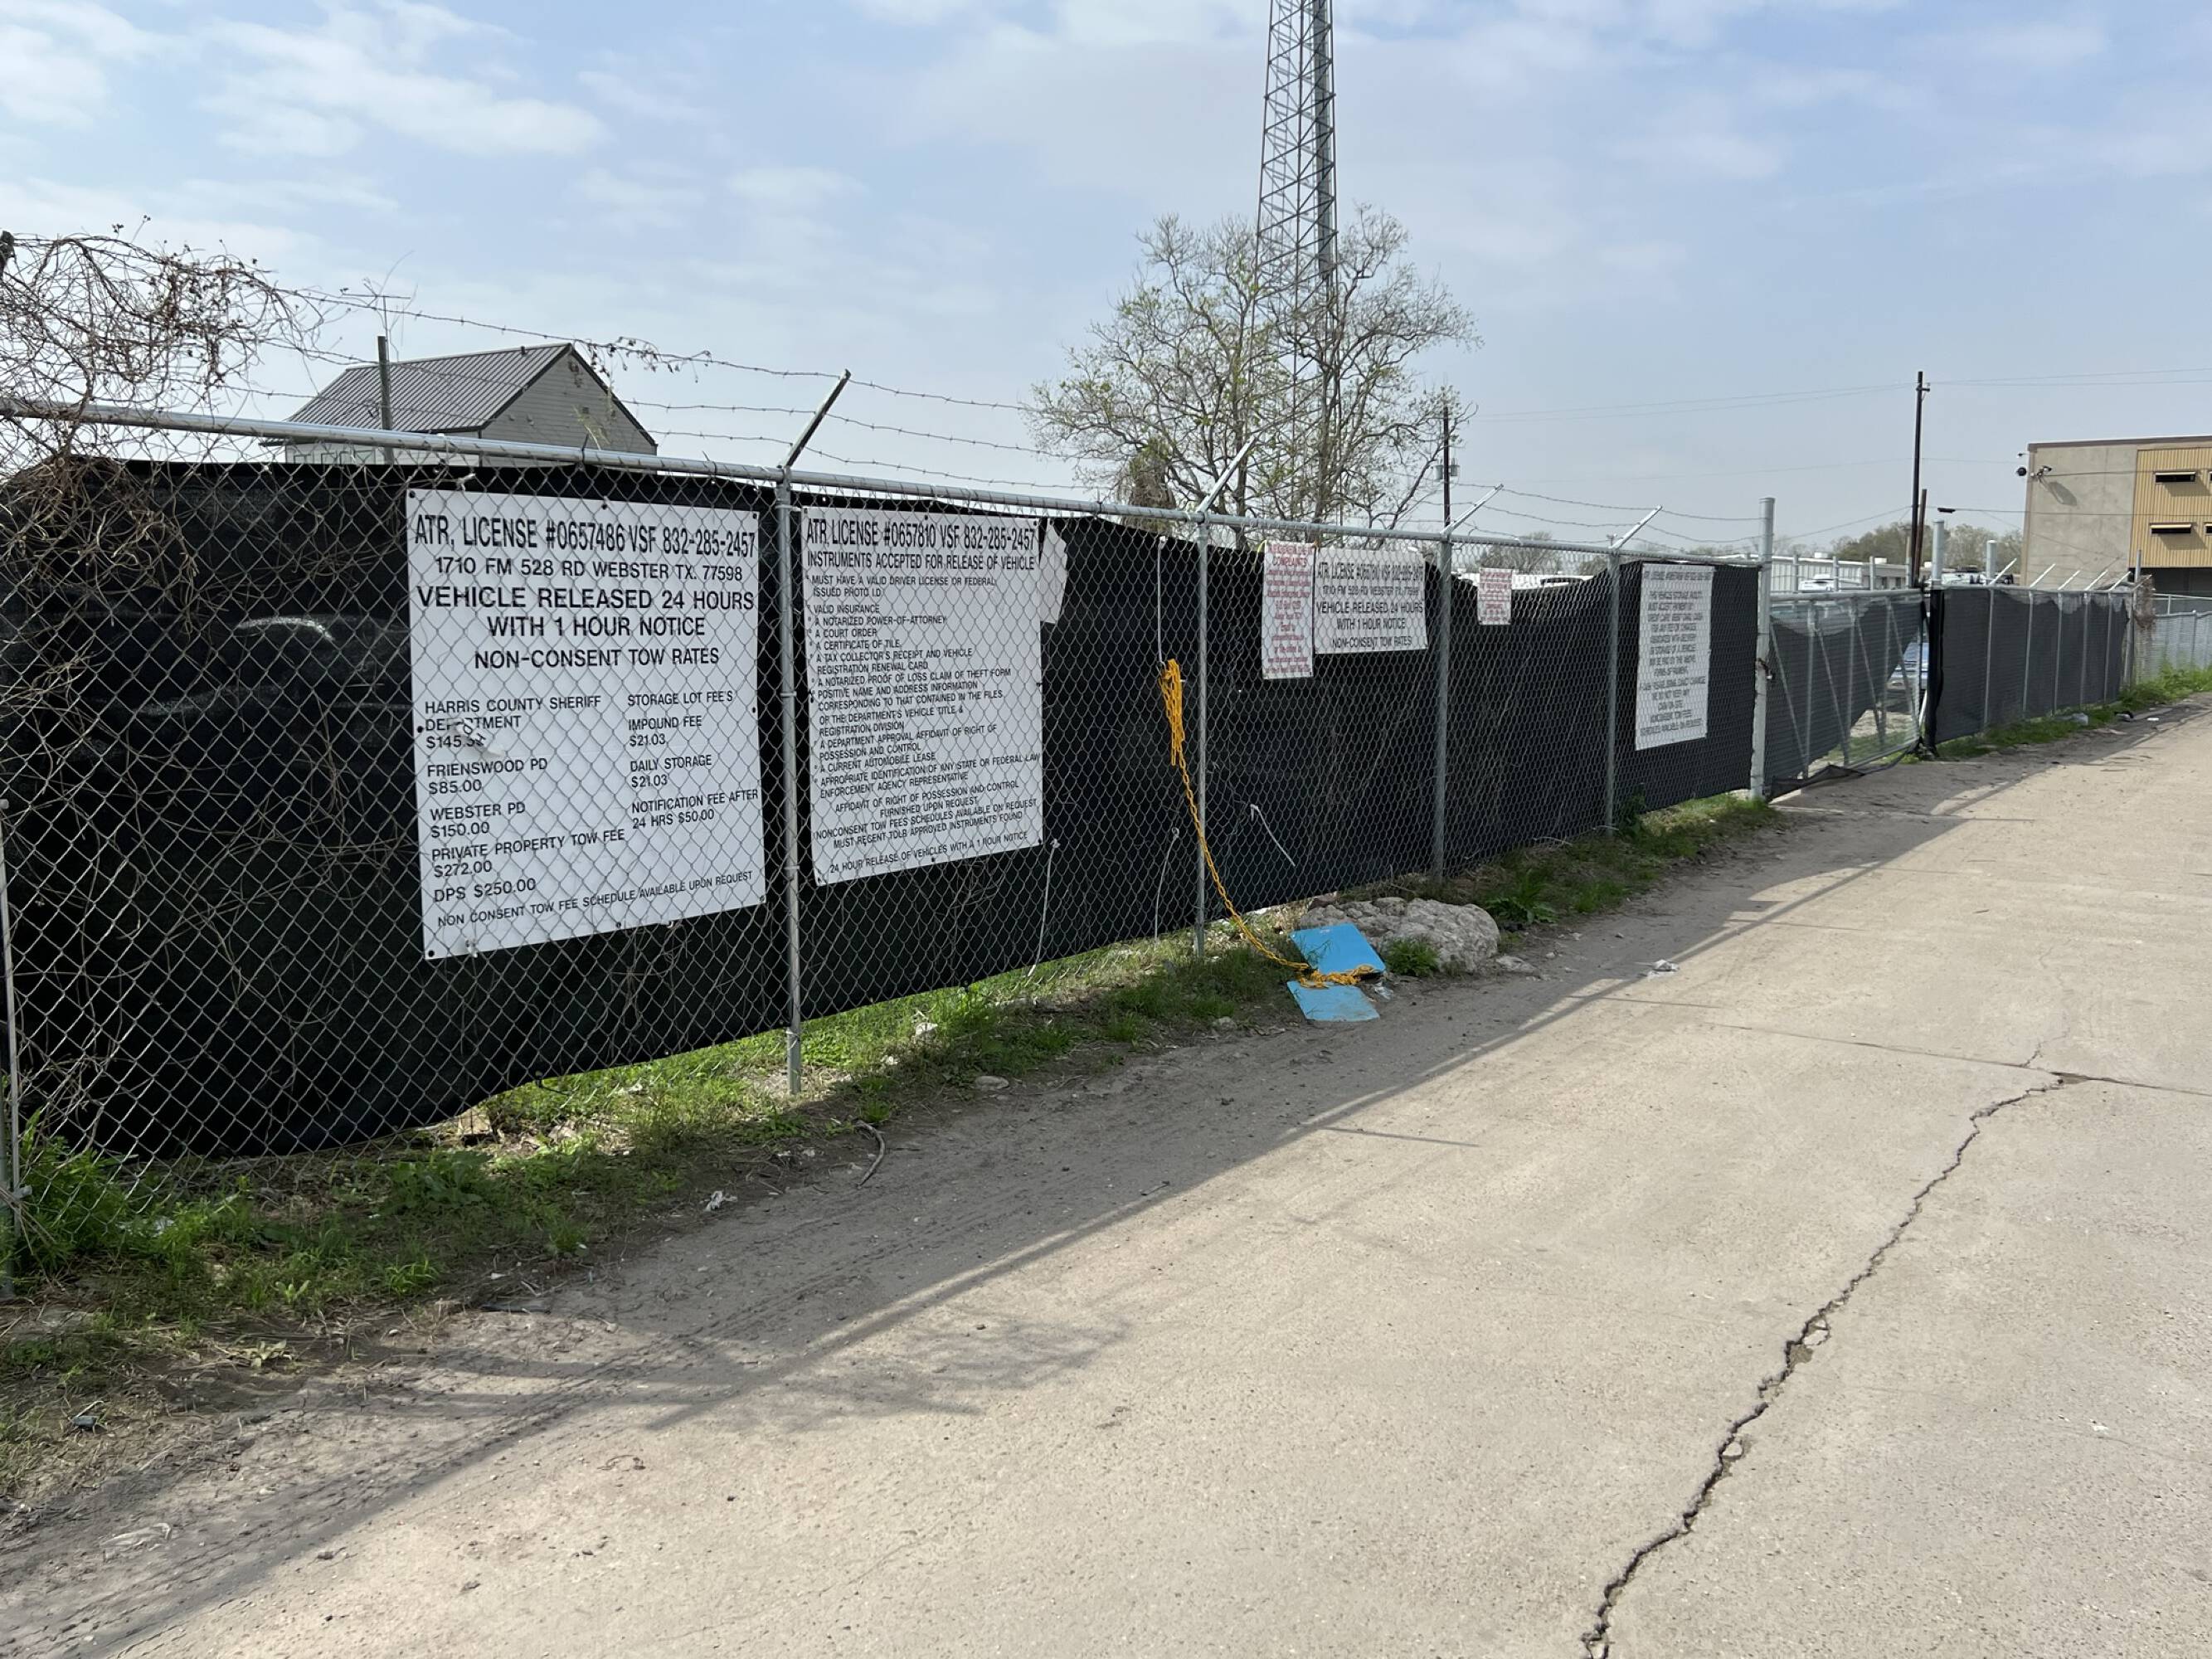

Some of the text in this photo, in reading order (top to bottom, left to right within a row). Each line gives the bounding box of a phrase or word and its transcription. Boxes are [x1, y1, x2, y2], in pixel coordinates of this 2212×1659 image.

[463, 517, 537, 547] LICENSE
[546, 519, 625, 551] #0657486
[630, 525, 656, 552] VSF
[664, 527, 755, 557] 832-285-2457
[832, 519, 1034, 550] LICENSE #0657810 VSF 832-285-2457
[808, 551, 1034, 570] INSTRUMENTS ACCEPTED FOR RELEASE OF VEHICLE
[435, 557, 742, 581] 1710 FM 528 RD WEBSTER TX. 77598
[867, 576, 887, 585] VALID
[417, 586, 754, 610] VEHICLE RELEASED 24 HOURS
[844, 587, 869, 596] PHOTO
[814, 605, 880, 614] VALID INSURANCE
[1316, 601, 1422, 614] VEHICLE RELEASED 24 HOURS
[487, 616, 705, 636] WITH 1 HOUR NOTICE
[823, 616, 863, 626] NOTARIZED
[1337, 617, 1405, 630] WITH HOUR NOTICE
[824, 628, 878, 638] COURT ORDER
[1393, 635, 1412, 646] RATES
[824, 640, 869, 650] CERTIFICATE
[475, 647, 719, 669] NON-CONSENT TOW RATES
[893, 648, 973, 659] RECEIPT VEHICLE
[817, 664, 868, 674] REGISTRATION
[908, 661, 928, 670] CARD
[908, 673, 927, 682] LOSS
[628, 691, 733, 706] STORAGE LOT FEE'S
[818, 688, 849, 698] POSITIVE
[853, 687, 873, 696] NAME
[877, 686, 891, 695] AND
[425, 696, 601, 713] HARRIS COUNTY SHERIFF
[425, 715, 522, 732] DETMENT
[629, 716, 702, 730] IMPOUND FEE
[819, 724, 871, 737] REGISTRATION
[426, 735, 484, 748] $145.
[630, 733, 665, 747] $21.03
[829, 736, 875, 748] DEPARTMENT
[819, 743, 921, 761] POSSESSION AND CONTROL
[427, 758, 547, 776] FRIENSWOOD PD
[630, 755, 712, 771] DAILY STORAGE
[828, 760, 861, 772] CURRENT
[914, 752, 936, 762] LEASE
[993, 756, 1023, 766] FEDERAL
[429, 779, 482, 795] $85.00
[631, 774, 668, 788] $21.03
[878, 780, 906, 791] AGENCY
[885, 780, 1019, 805] RIGHT POSSESSION CONTROL
[632, 790, 758, 813] NOTIFICATION FEE AFTER
[946, 796, 978, 808] REQUEST
[430, 801, 525, 820] WEBSTER PD
[890, 817, 907, 827] FEES
[911, 810, 953, 825] SCHEDULES
[1005, 799, 1037, 810] REQUEST
[430, 821, 489, 838] $150.00
[633, 817, 646, 830] 24
[651, 814, 673, 826] HRS
[431, 830, 625, 861] PRIVATE PROPERTY TOW FEE
[834, 838, 854, 849] MUST
[842, 831, 1028, 871] HOUR RELEASE VEHICLES NOTICE
[434, 860, 492, 878] $272.00
[435, 878, 536, 902] DPS $250.00
[438, 871, 753, 927] NON CONSENT TOW FEE SCHEDULE AVAILABLE UPON REQUEST
